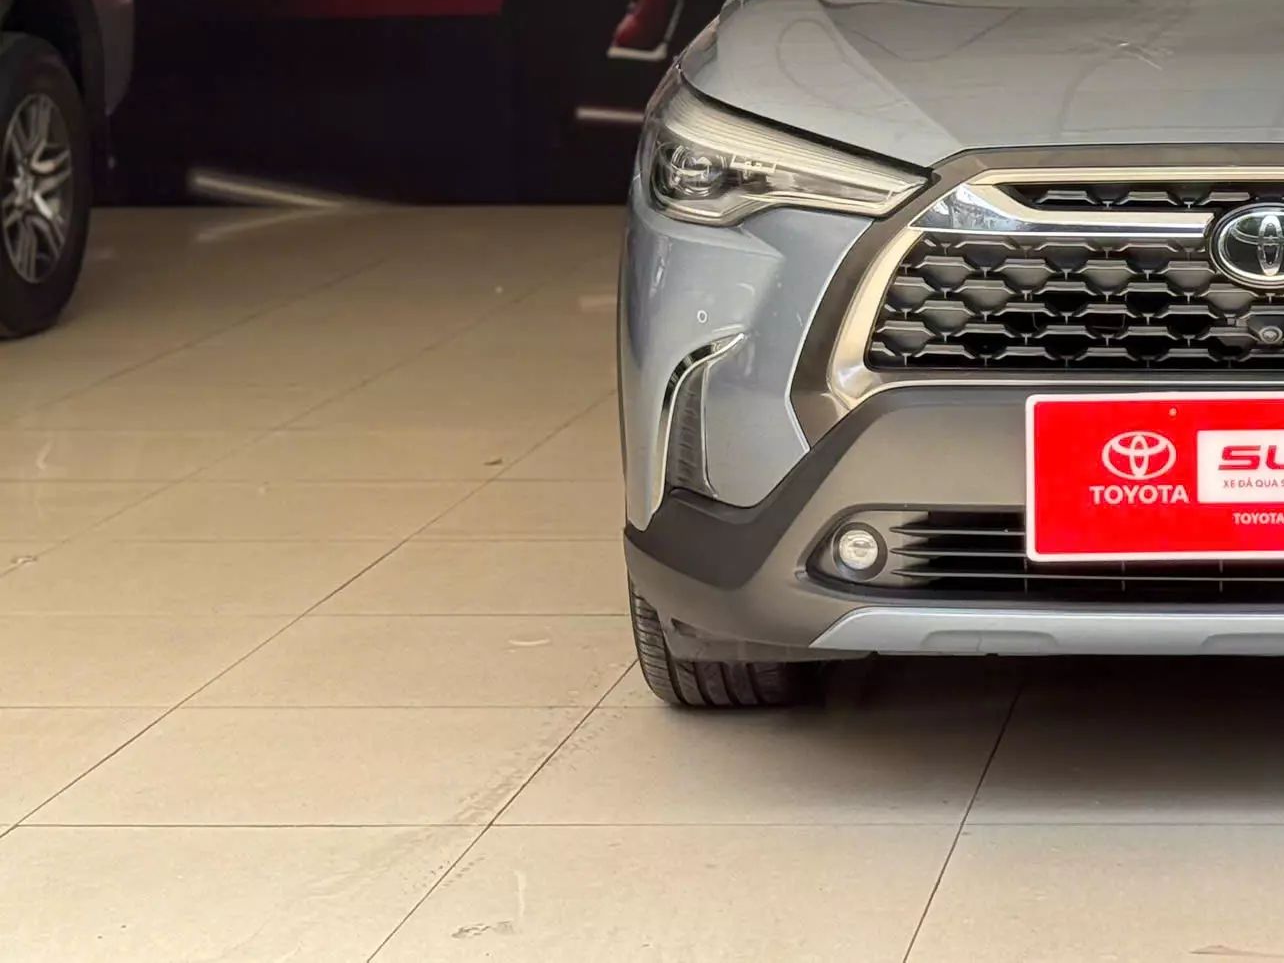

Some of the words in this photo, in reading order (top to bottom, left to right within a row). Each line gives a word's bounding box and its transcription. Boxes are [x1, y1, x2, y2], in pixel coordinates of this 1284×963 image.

[1223, 479, 1235, 488] XE
[1255, 479, 1278, 488] QUA
[1089, 485, 1189, 504] TOYOTA
